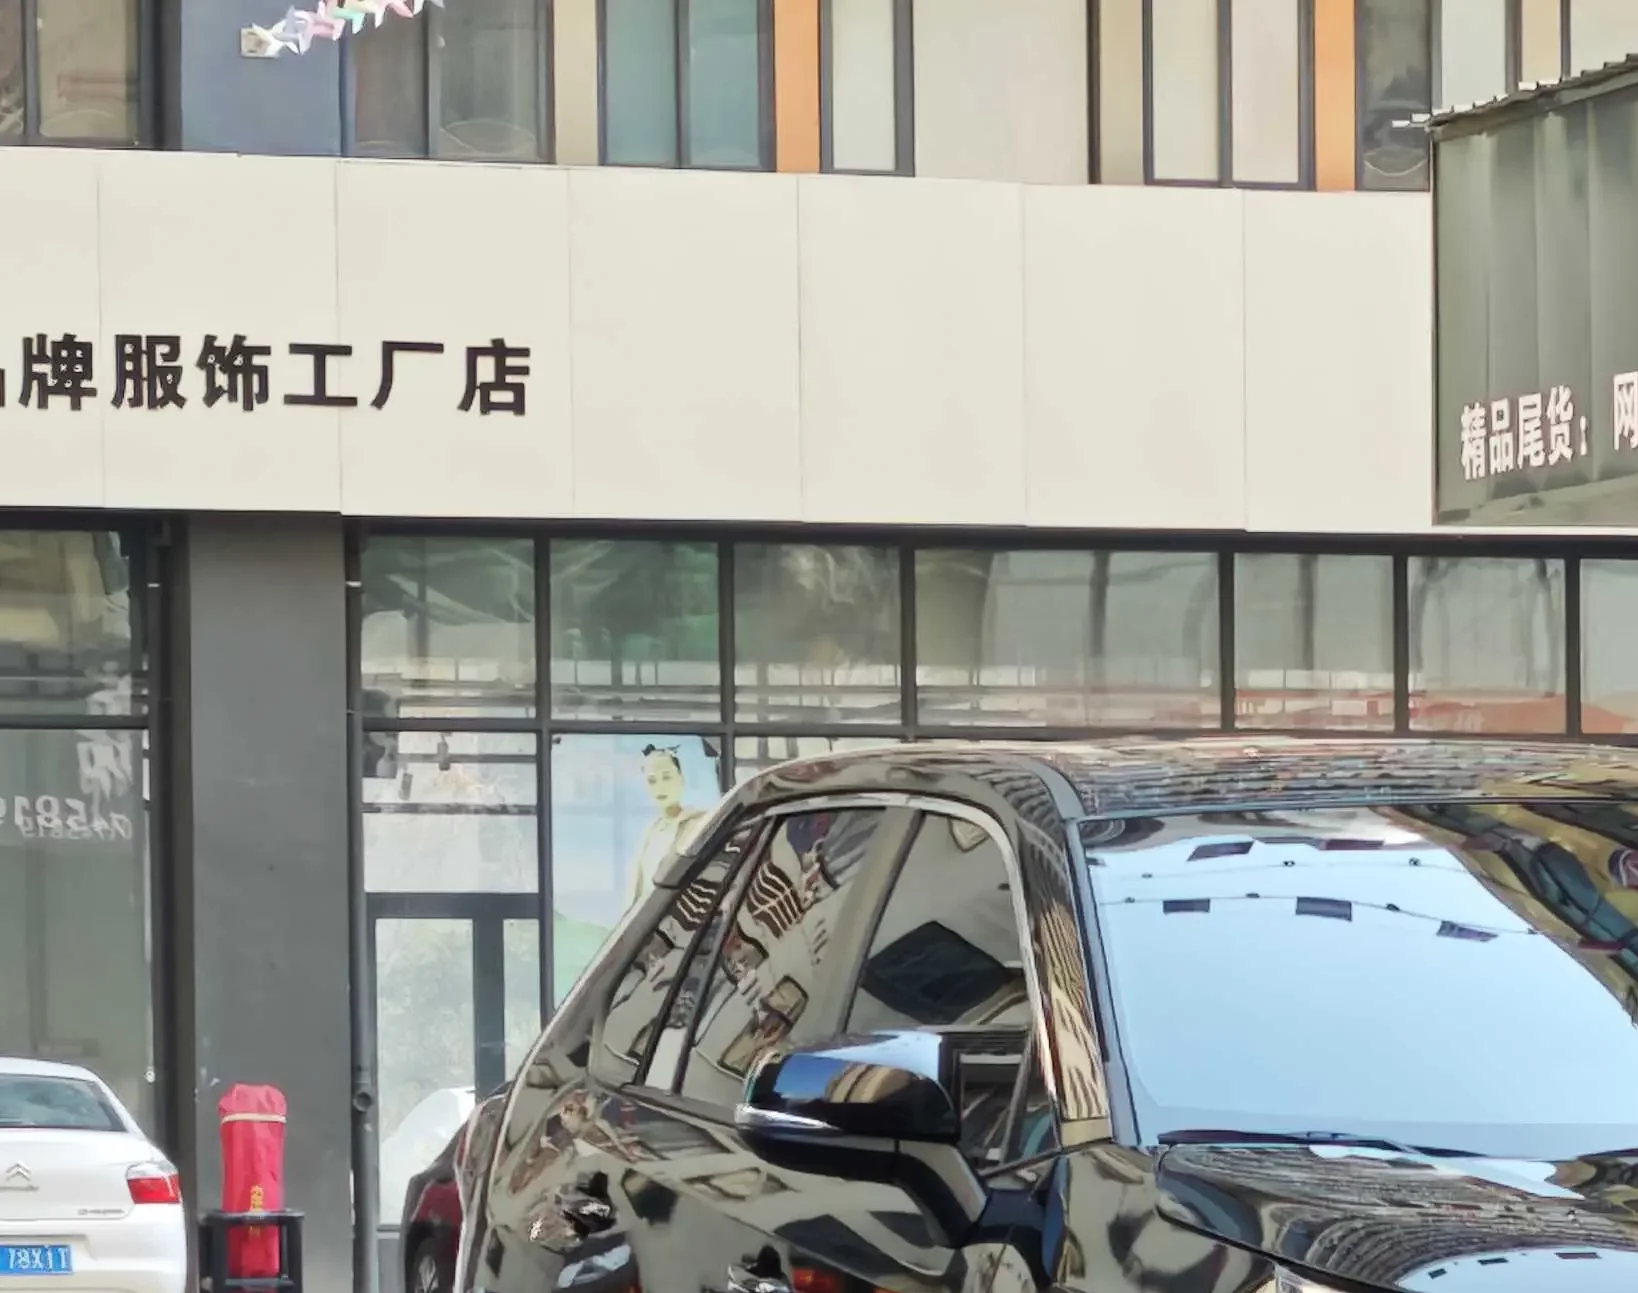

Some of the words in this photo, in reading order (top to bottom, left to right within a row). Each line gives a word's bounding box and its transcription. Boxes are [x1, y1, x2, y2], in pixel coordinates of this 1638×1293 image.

[0, 333, 532, 416] 牌服饰工厂店
